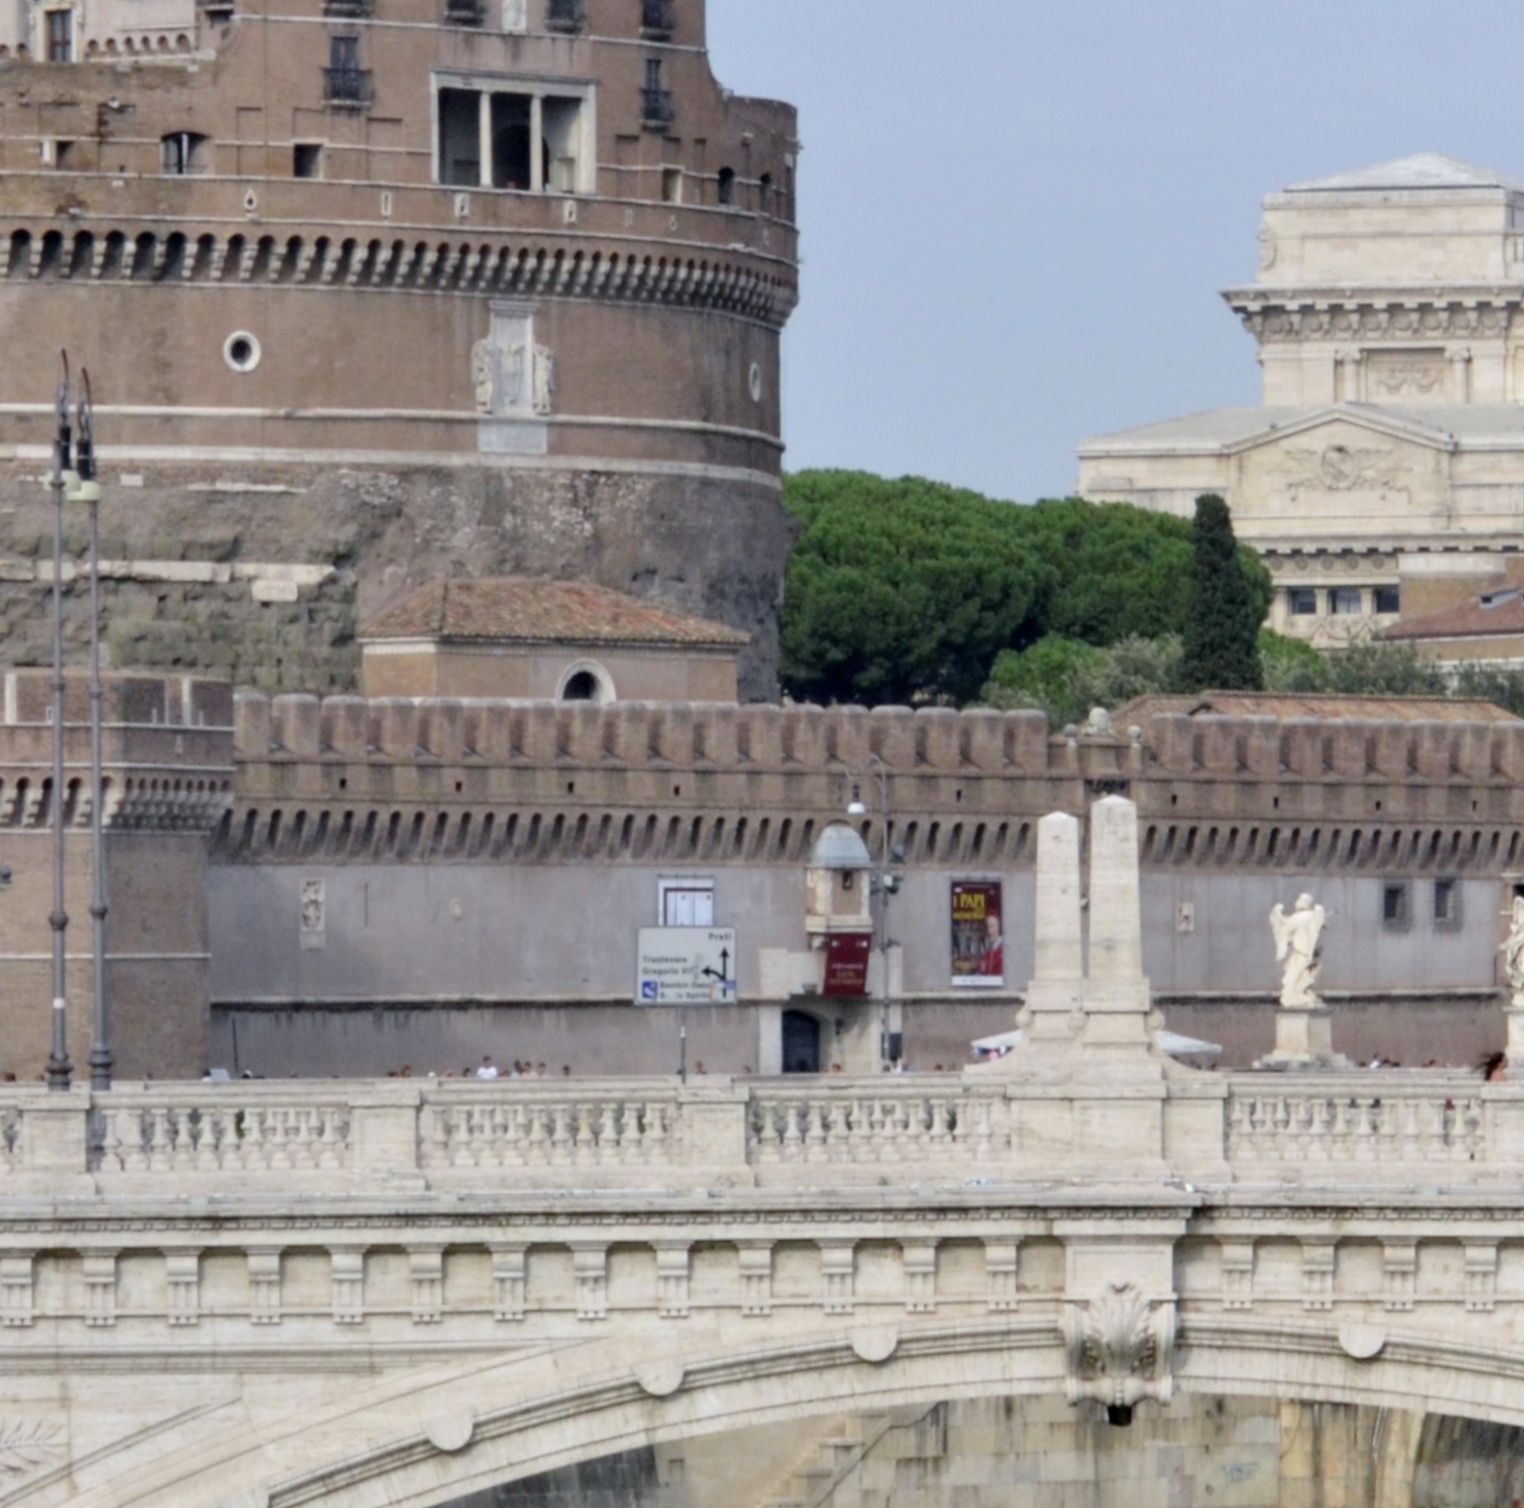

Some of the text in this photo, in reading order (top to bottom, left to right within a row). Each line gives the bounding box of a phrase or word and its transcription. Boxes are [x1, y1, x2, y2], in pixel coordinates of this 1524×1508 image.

[960, 893, 985, 908] PAPI
[708, 932, 732, 941] Prati
[641, 967, 679, 976] Gregorio
[660, 981, 688, 989] Bambin
